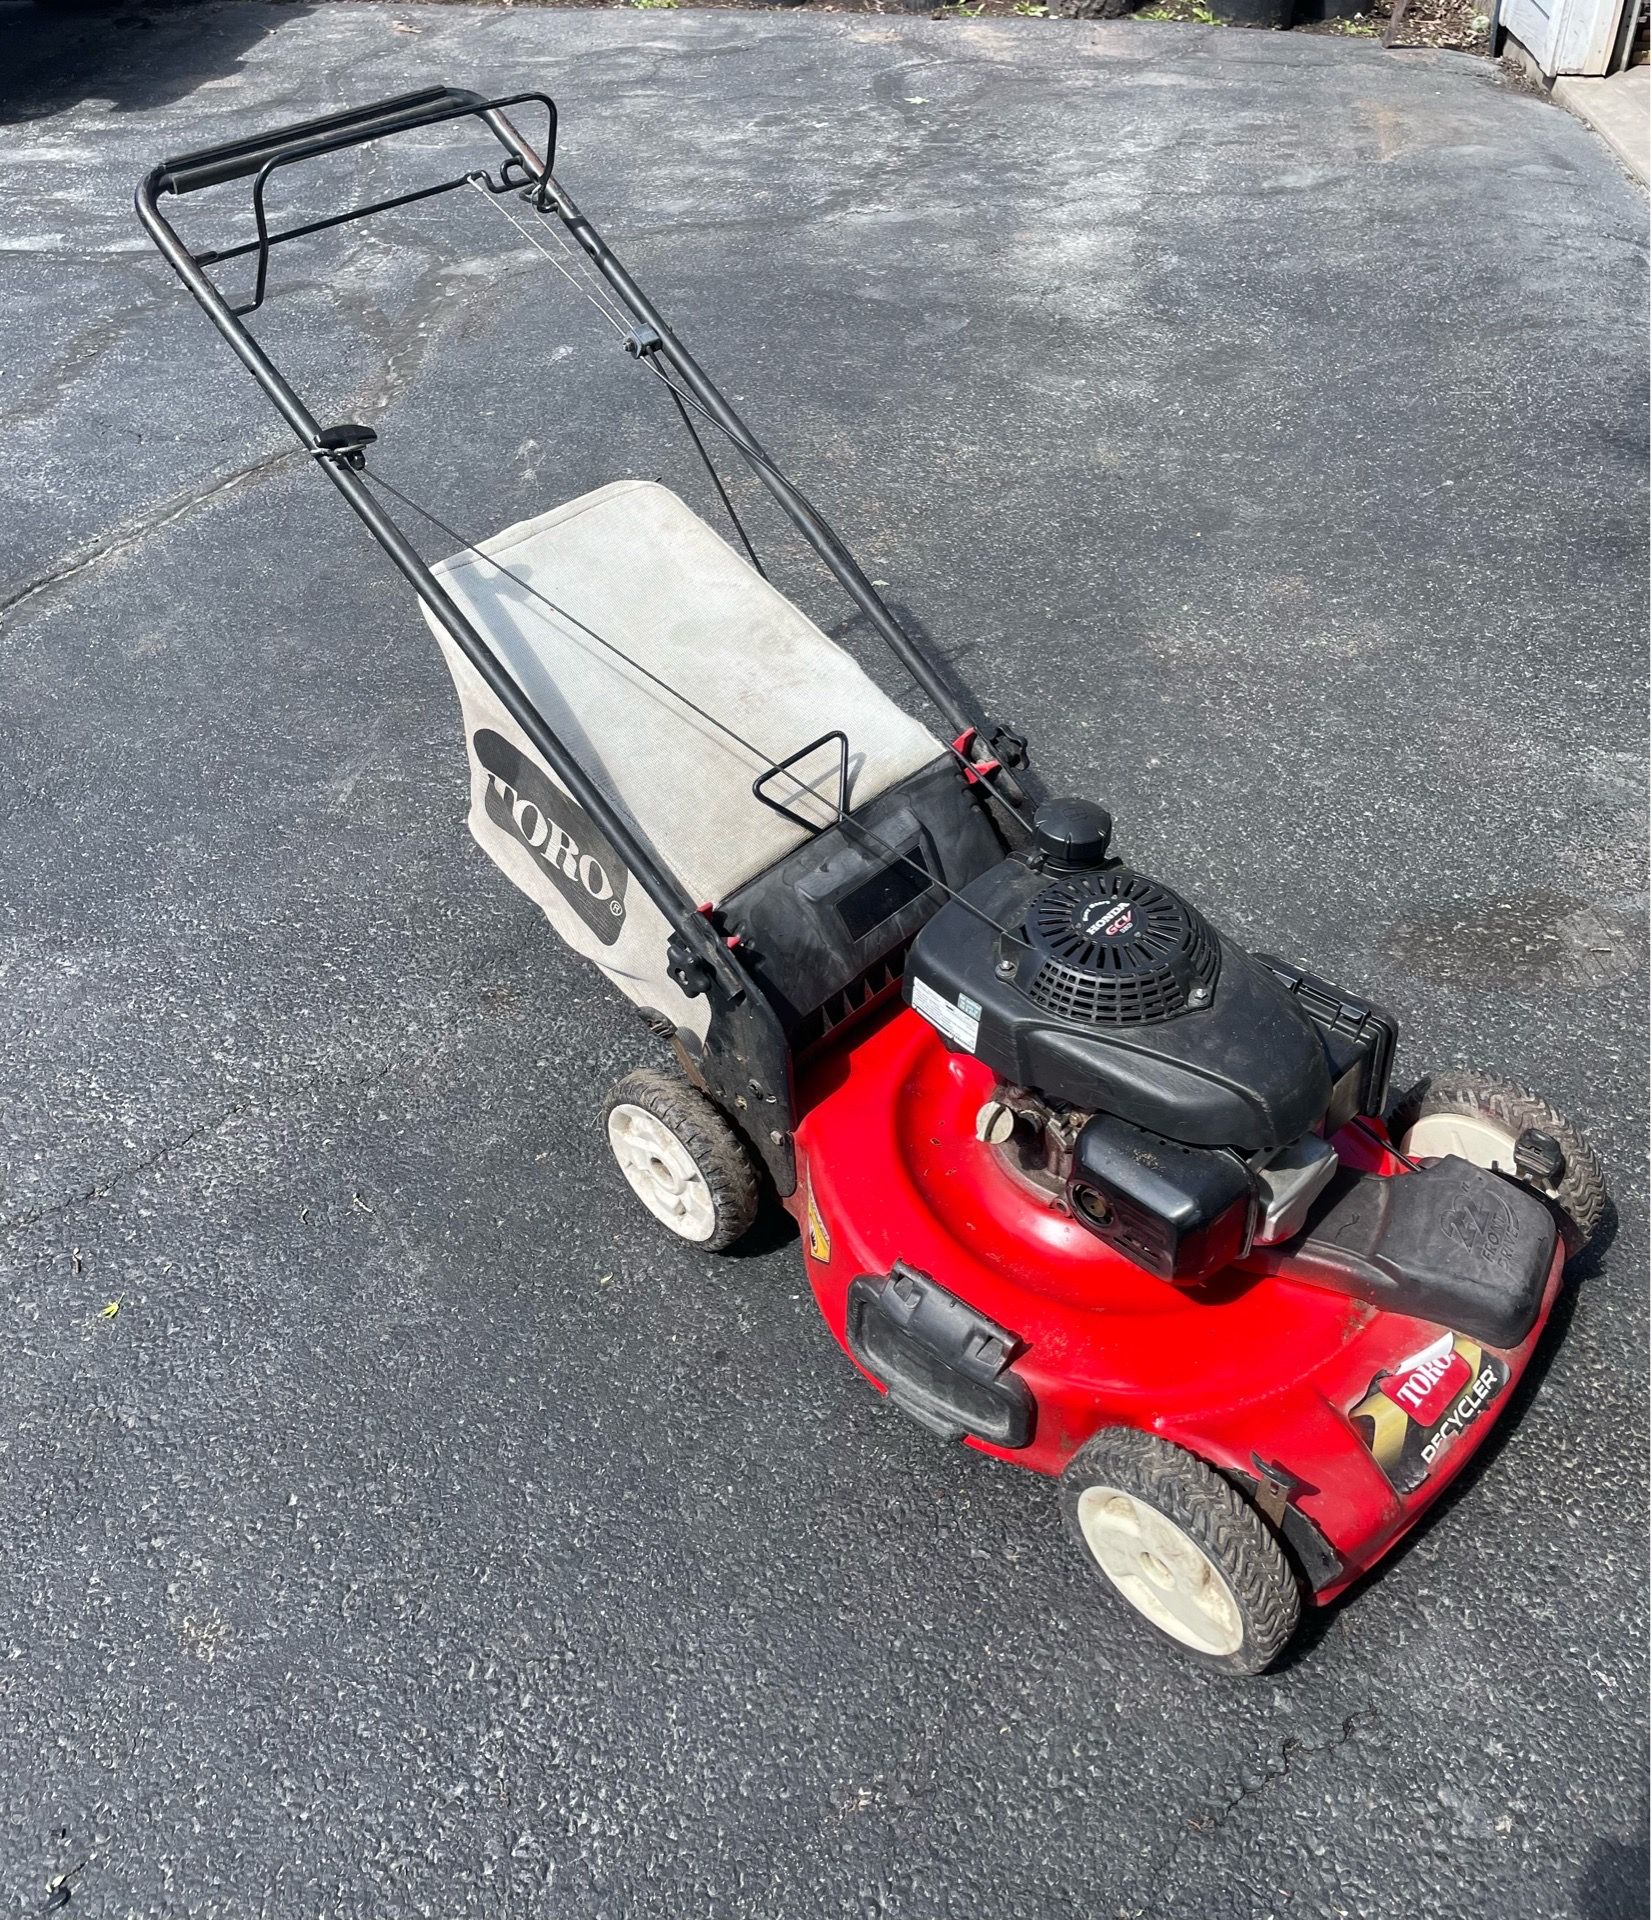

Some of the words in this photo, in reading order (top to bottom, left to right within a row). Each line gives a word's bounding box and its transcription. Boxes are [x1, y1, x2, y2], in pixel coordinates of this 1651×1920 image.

[484, 768, 613, 900] TORO
[1085, 902, 1130, 935] HONDA
[1105, 910, 1131, 936] GCV
[1482, 1211, 1504, 1263] FRONT
[1396, 1354, 1452, 1408] TORO
